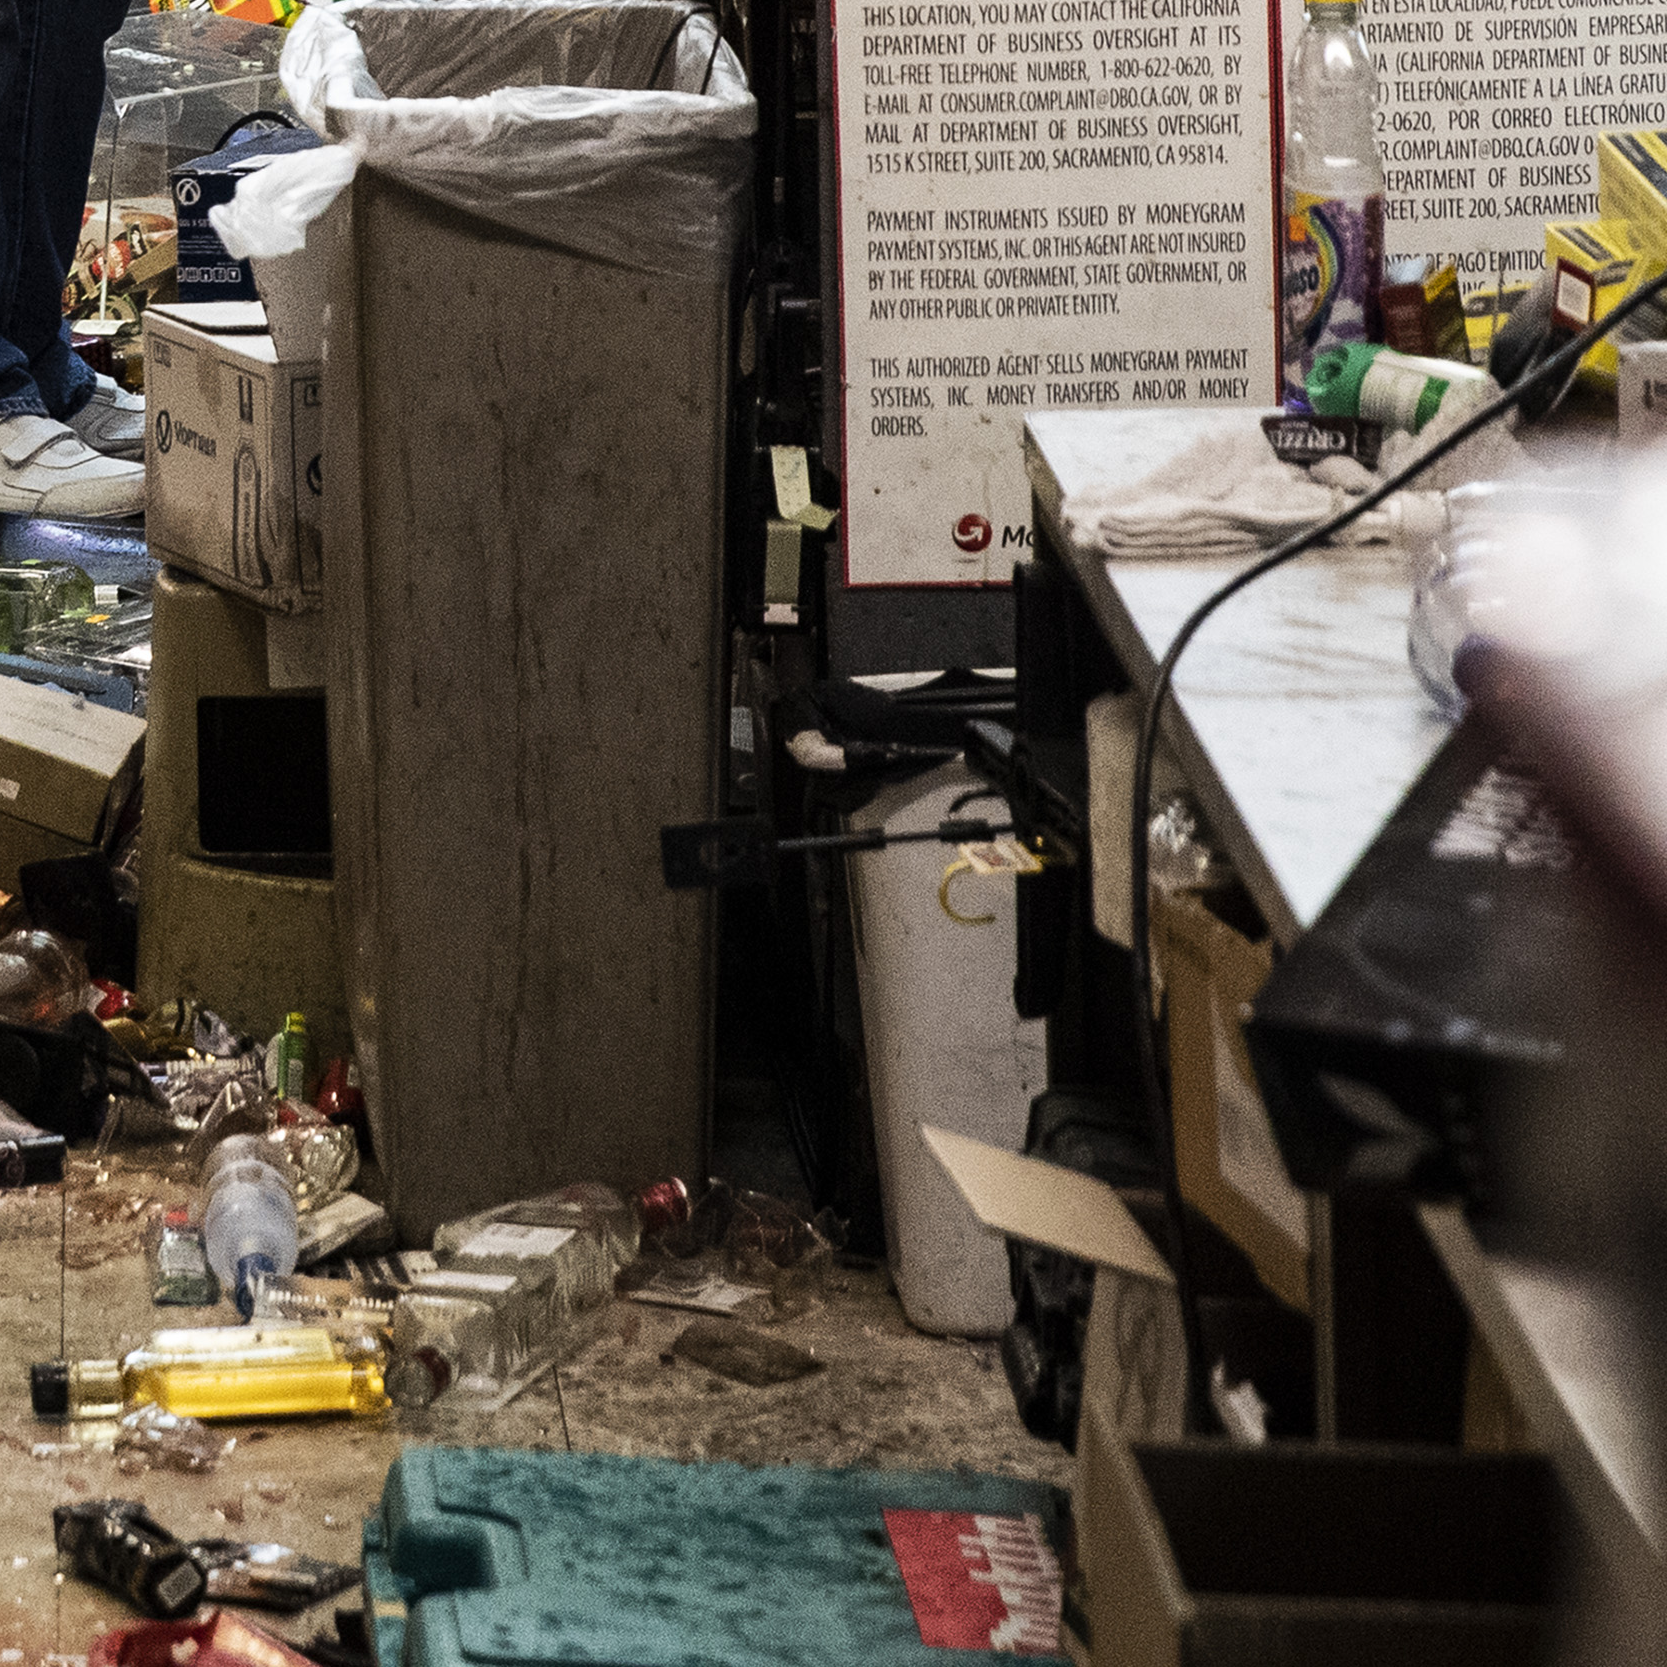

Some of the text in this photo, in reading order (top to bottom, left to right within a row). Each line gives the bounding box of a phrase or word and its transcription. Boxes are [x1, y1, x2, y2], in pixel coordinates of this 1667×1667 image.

[862, 4, 896, 29] THIS
[901, 3, 974, 29] LOCATION,
[979, 3, 1010, 26] YOU
[1014, 2, 1047, 25] MAY
[862, 23, 1242, 59] DEPARTMENT OF BUSINESS OVERSIGHT AT ITS
[863, 53, 1242, 88] TOLL-FREE TELEPHONE NUMBER, 1-800-622-0620, BY
[864, 82, 1243, 118] E-MAIL AT CONSUMER.COMPLAINT@DBO.CA.GOV, OR BY
[864, 112, 1243, 147] MAIL AT DEPARTMENT OF BUSINESS OVERSIGHT,
[866, 142, 1229, 177] 1515 K STREET, SUITE 200, SACRAMENTO, CA 95814.
[866, 200, 1246, 233] PAYMENT INSTRUMENTS ISSUED BY MONEYGRAM
[867, 237, 935, 263] PAYMENT
[938, 237, 1002, 264] SYSTEMS,
[1032, 236, 1052, 260] OR
[1053, 235, 1083, 259] THIS
[1084, 233, 1127, 258] AGENT
[1130, 231, 1156, 257] ARE
[1158, 231, 1184, 255] NOT
[1187, 230, 1247, 256] INSURED
[867, 257, 1248, 293] BY THE FEDERAL GOVERNMENT, STATE GOVERNMENT, OR
[868, 291, 1121, 322] ANY OTHER PUBLIC OR PRIVATE ENTITY.
[869, 346, 1249, 380] THIS AUTHORIZED AGENT SELLS MONEYGRAM PAYMENT
[870, 384, 935, 411] SYSTEMS,
[986, 382, 1036, 408] MONEY
[1045, 379, 1121, 408] TRANSFERS
[1131, 376, 1187, 405] AND/OR
[1198, 376, 1250, 403] MONEY
[870, 413, 928, 439] ORDERS.
